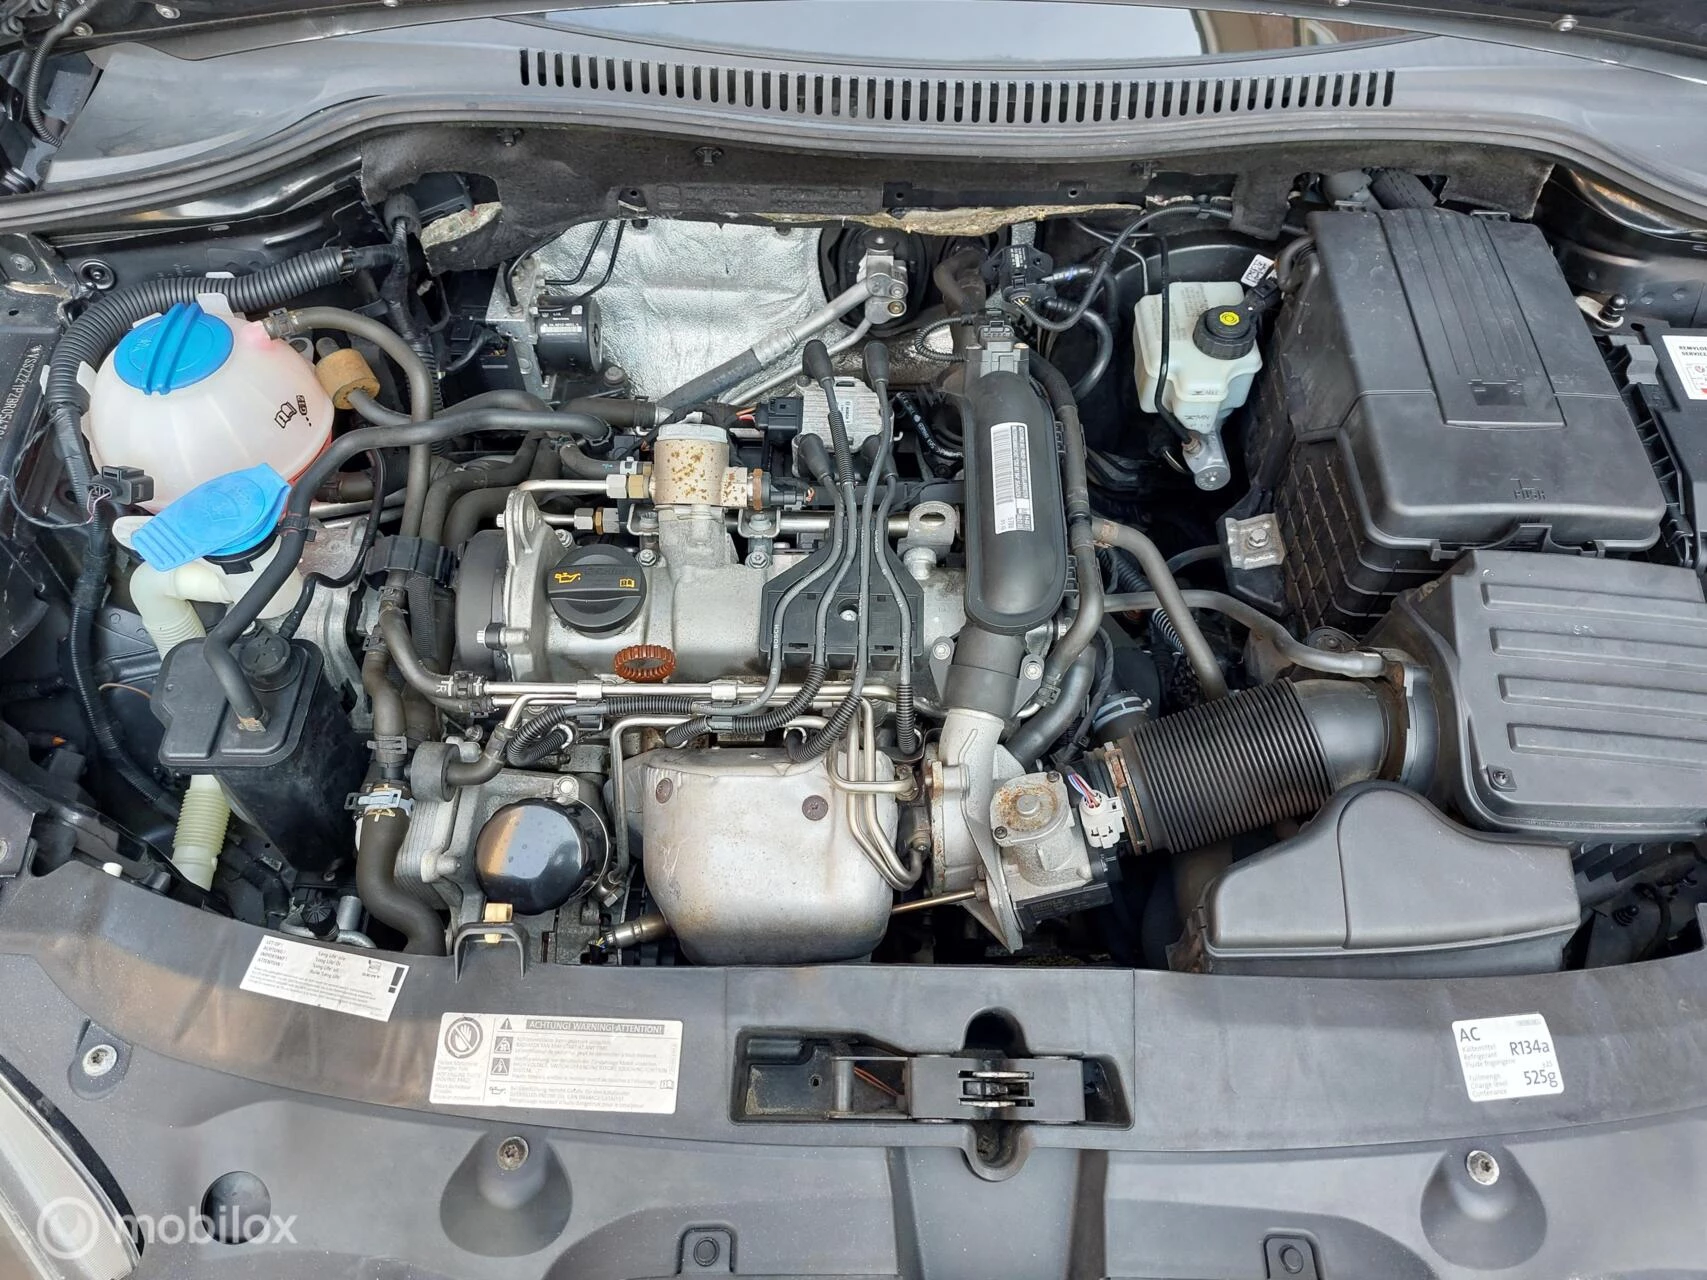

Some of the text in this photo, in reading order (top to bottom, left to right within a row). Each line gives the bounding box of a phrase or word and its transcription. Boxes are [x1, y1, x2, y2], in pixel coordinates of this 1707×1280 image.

[529, 1021, 662, 1033] ACHTUNG! WARNING! ATTENTION!
[1460, 1027, 1481, 1042] AC
[1509, 1040, 1550, 1056] R134a
[1523, 1069, 1558, 1088] 525g
